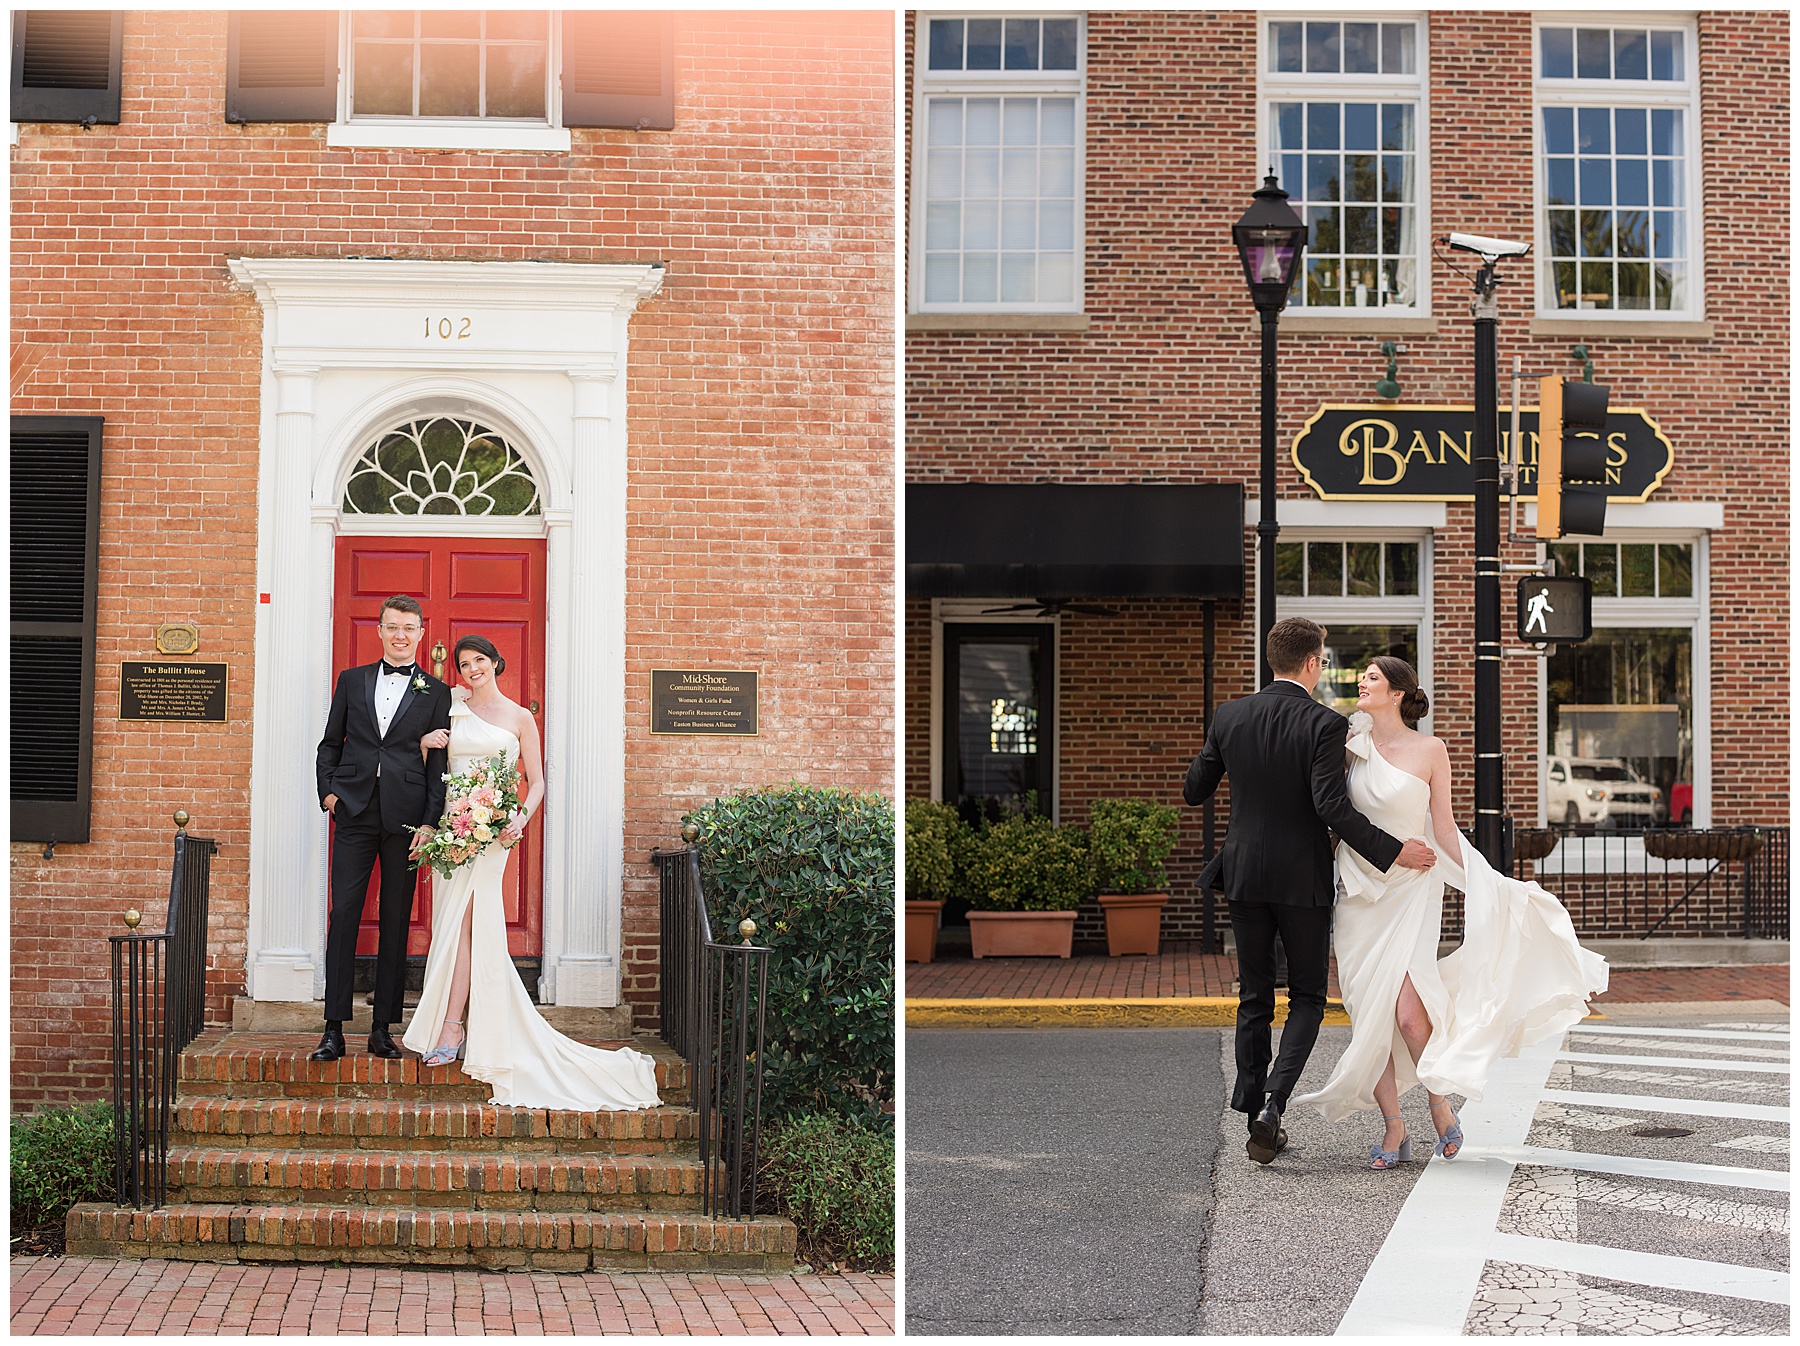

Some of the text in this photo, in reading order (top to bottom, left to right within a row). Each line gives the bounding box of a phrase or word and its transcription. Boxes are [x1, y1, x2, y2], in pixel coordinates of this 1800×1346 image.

[424, 317, 471, 340] 102
[682, 674, 727, 684] Mid-Shore
[670, 684, 705, 692] Community
